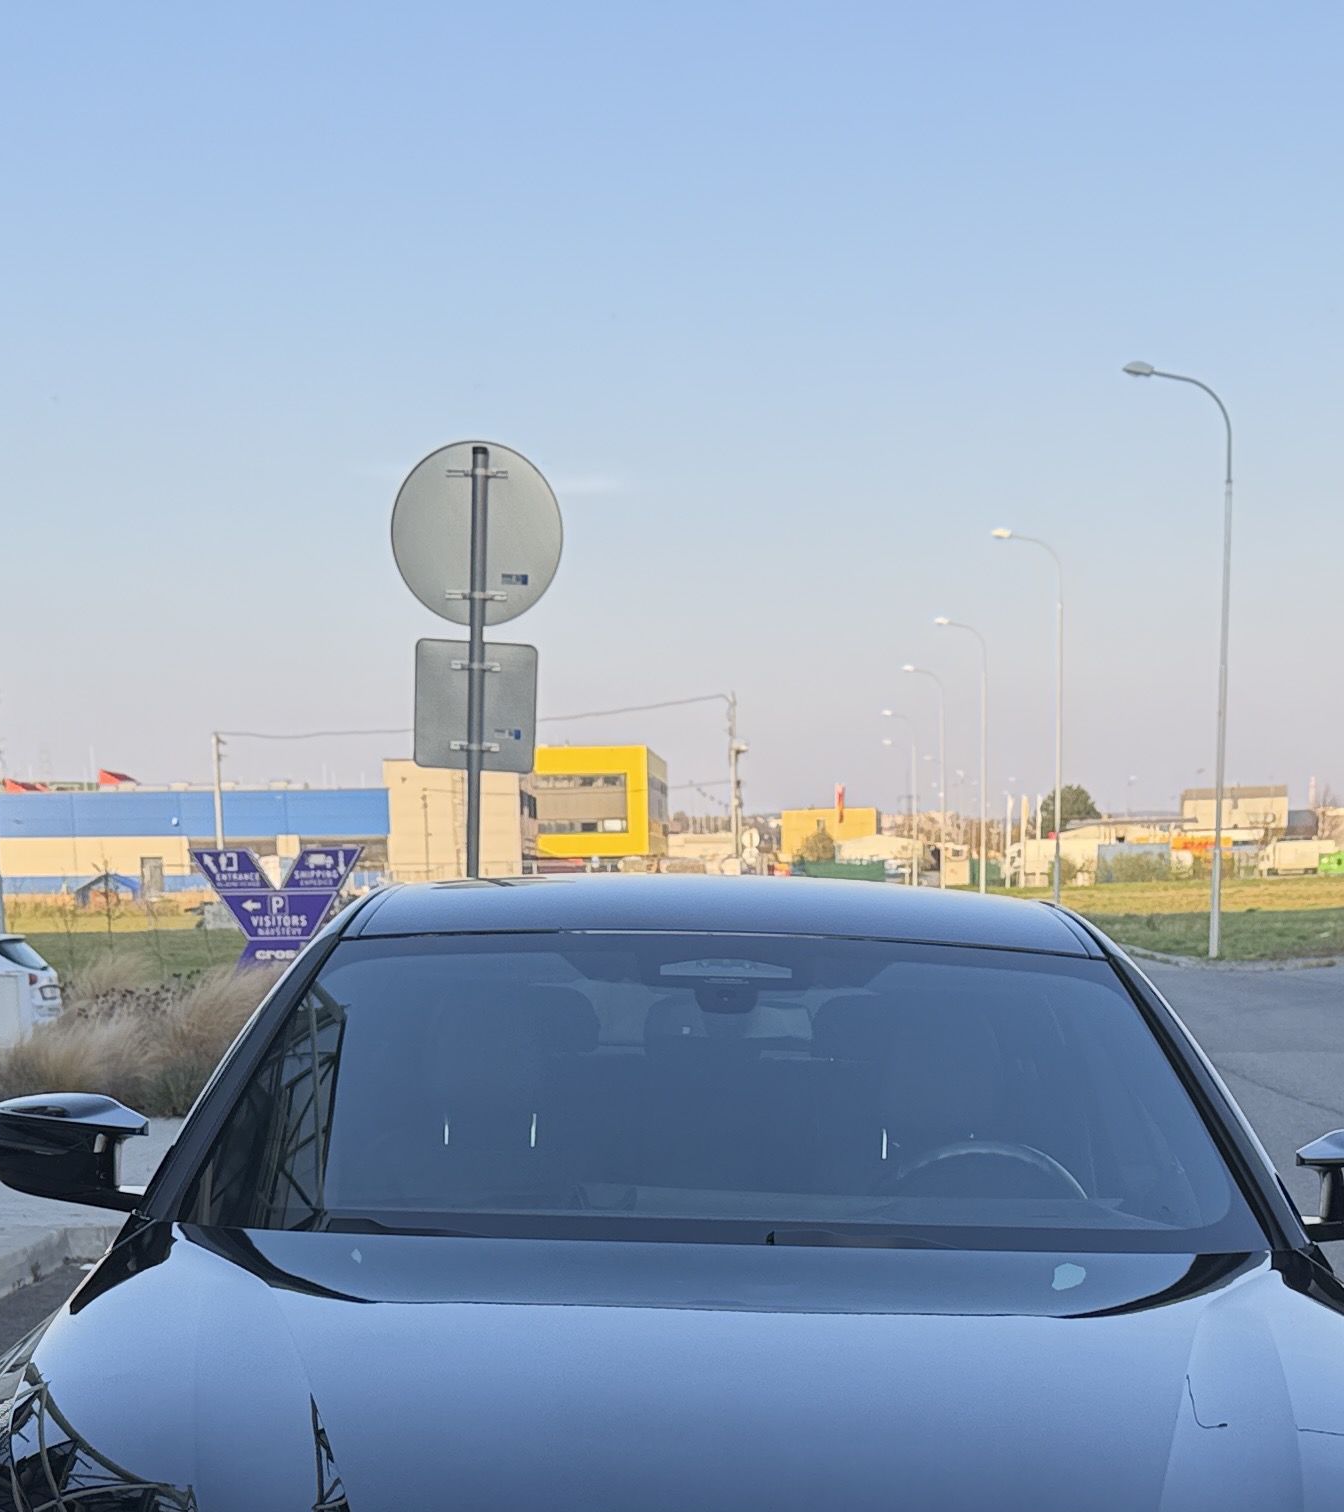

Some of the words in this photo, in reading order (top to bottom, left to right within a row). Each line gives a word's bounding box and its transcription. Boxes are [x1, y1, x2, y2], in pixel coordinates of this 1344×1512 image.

[293, 869, 339, 880] SHIPPING
[271, 896, 284, 915] P
[250, 915, 308, 928] VISITORS
[255, 949, 297, 960] cros
